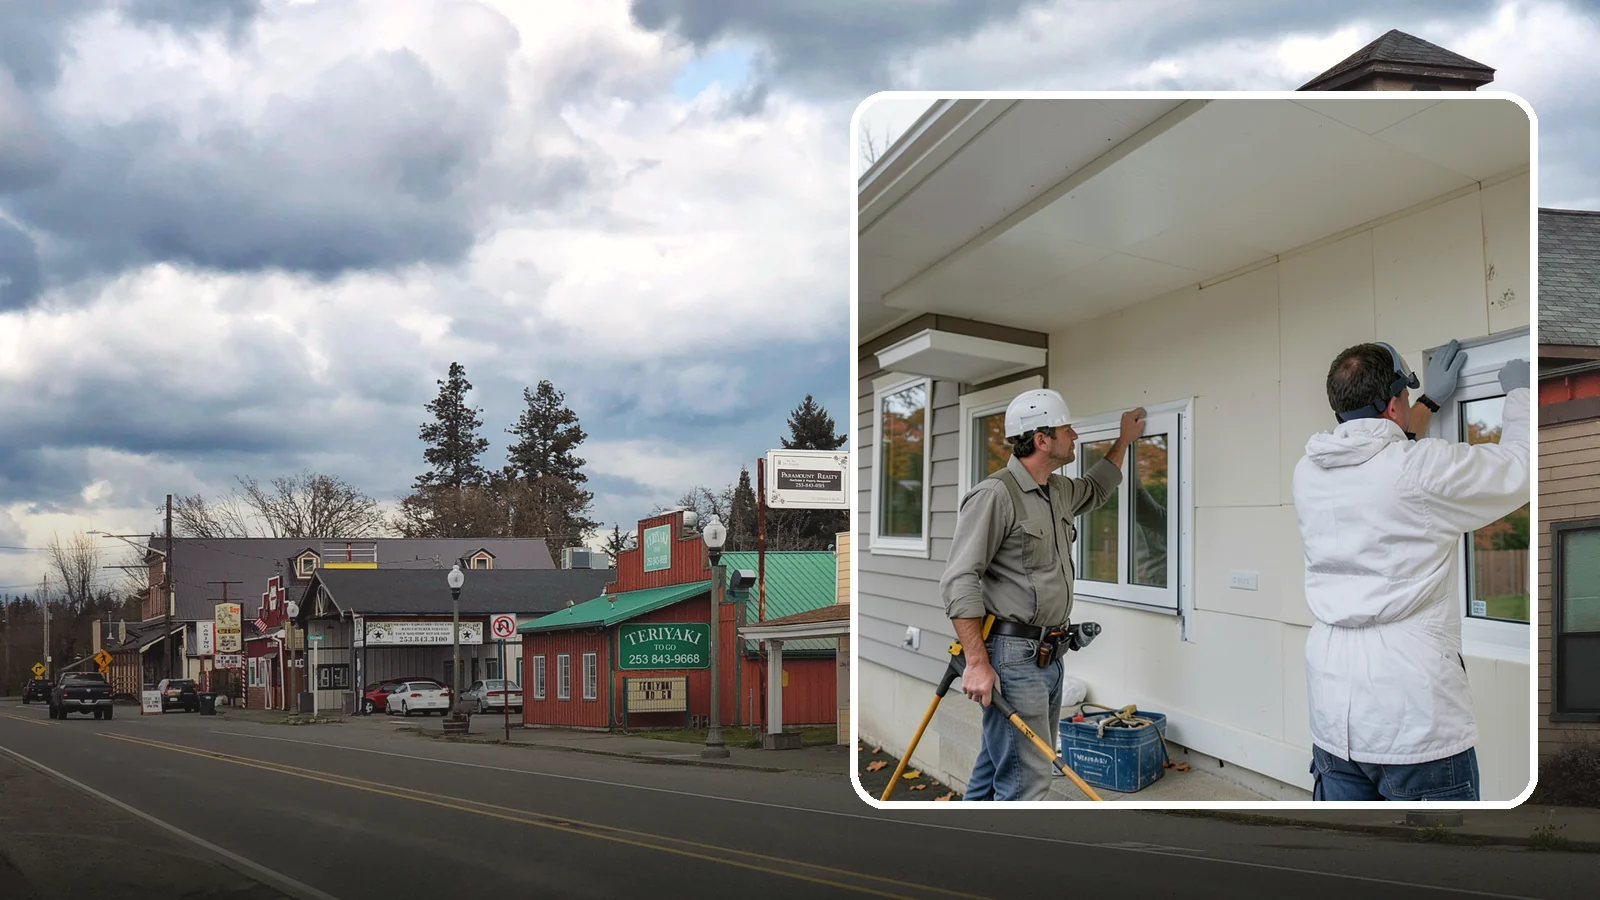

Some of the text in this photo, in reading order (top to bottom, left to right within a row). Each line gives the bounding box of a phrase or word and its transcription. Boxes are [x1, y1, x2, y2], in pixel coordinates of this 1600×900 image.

[817, 472, 839, 480] REALTY
[625, 627, 702, 646] TERIYAKI
[629, 654, 700, 665] 253 843-9668
[639, 681, 672, 690] TERIYAKI
